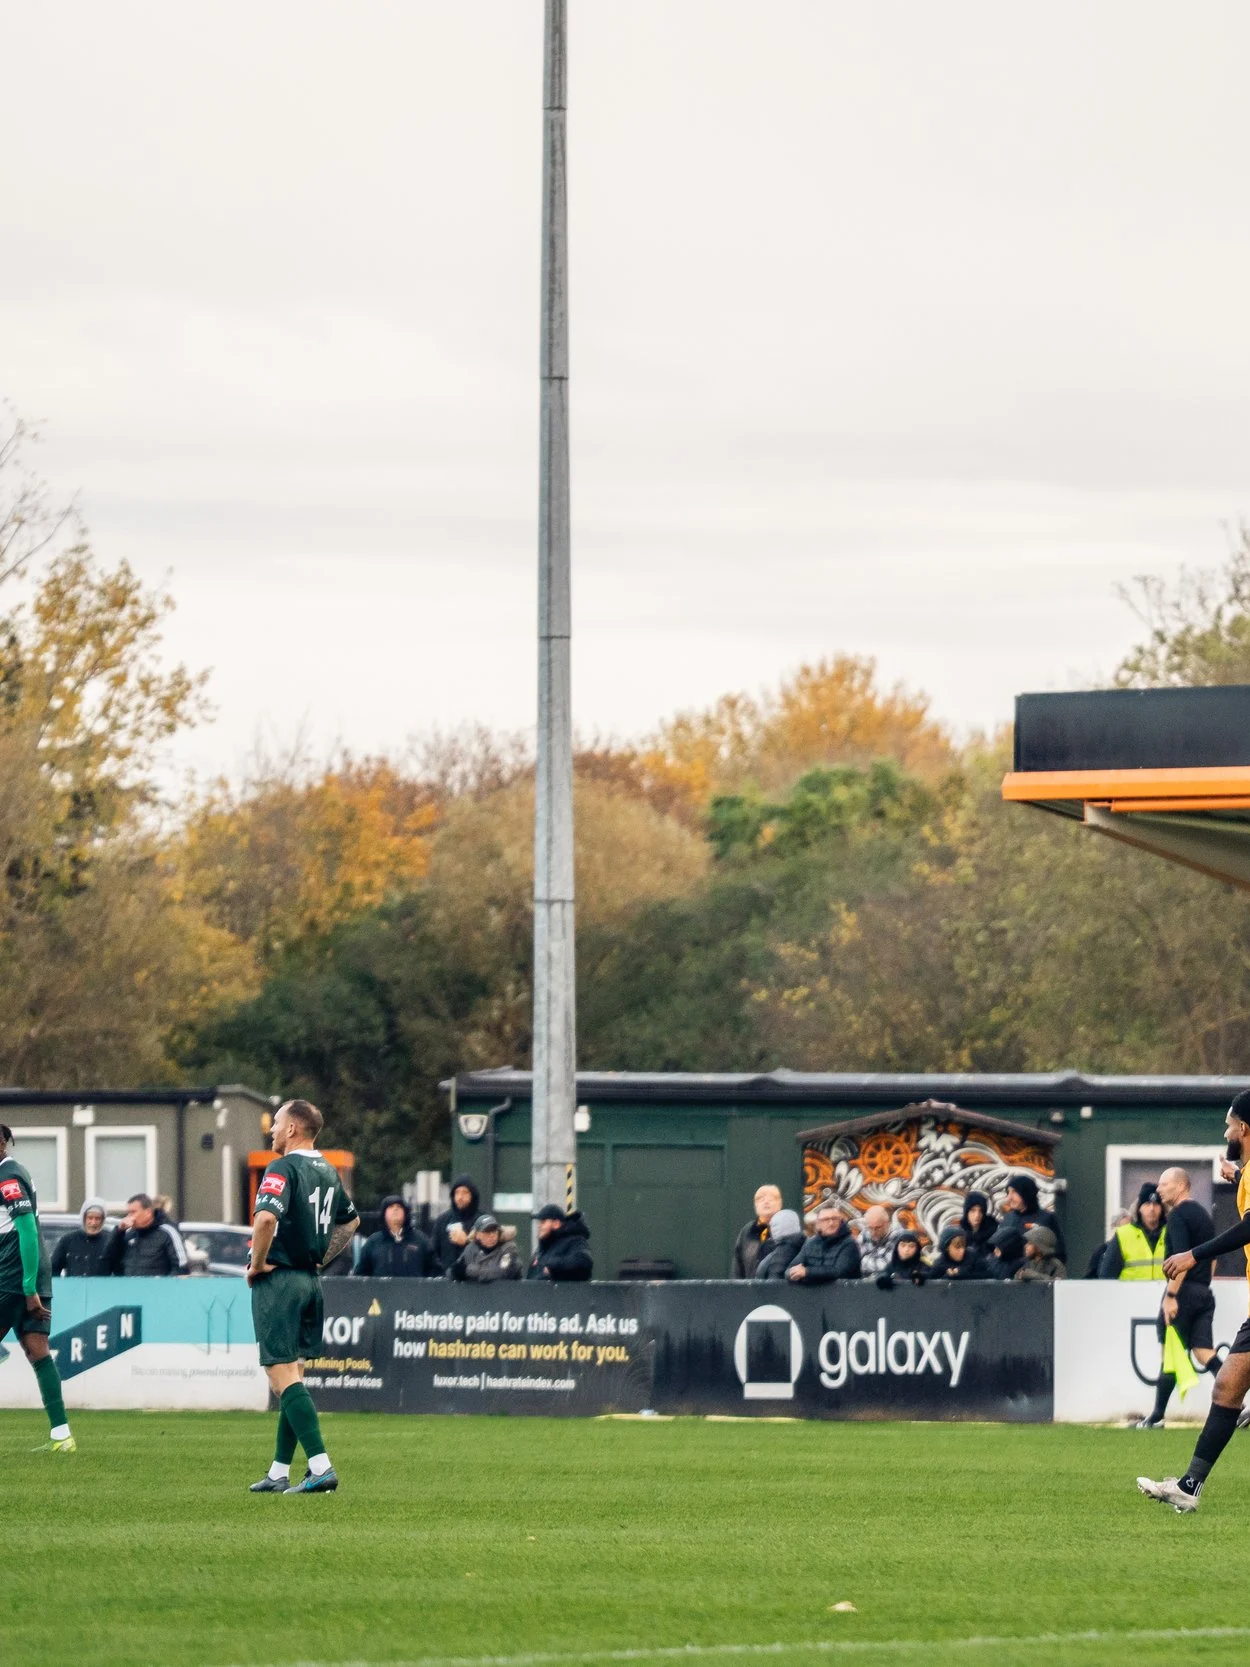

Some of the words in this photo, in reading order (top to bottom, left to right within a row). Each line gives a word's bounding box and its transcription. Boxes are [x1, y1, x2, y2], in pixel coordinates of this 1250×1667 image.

[307, 1186, 335, 1235] 14
[394, 1310, 463, 1331] Hashrate
[466, 1312, 499, 1336] paid
[502, 1314, 525, 1332] for
[527, 1314, 556, 1333] this
[559, 1314, 583, 1333] ad.
[586, 1315, 616, 1334] Ask
[618, 1319, 638, 1334] us
[314, 1357, 345, 1372] Mining
[346, 1358, 373, 1372] Pools,
[393, 1338, 426, 1358] how
[428, 1338, 496, 1359] hashrate
[498, 1343, 527, 1360] can
[530, 1341, 568, 1360] work
[571, 1341, 592, 1360] for
[597, 1345, 630, 1365] you.
[818, 1317, 970, 1388] galaxy
[325, 1375, 343, 1388] and
[344, 1375, 382, 1388] Services
[433, 1373, 480, 1388] luxor.tech
[487, 1375, 576, 1390] hashrateindex.com
